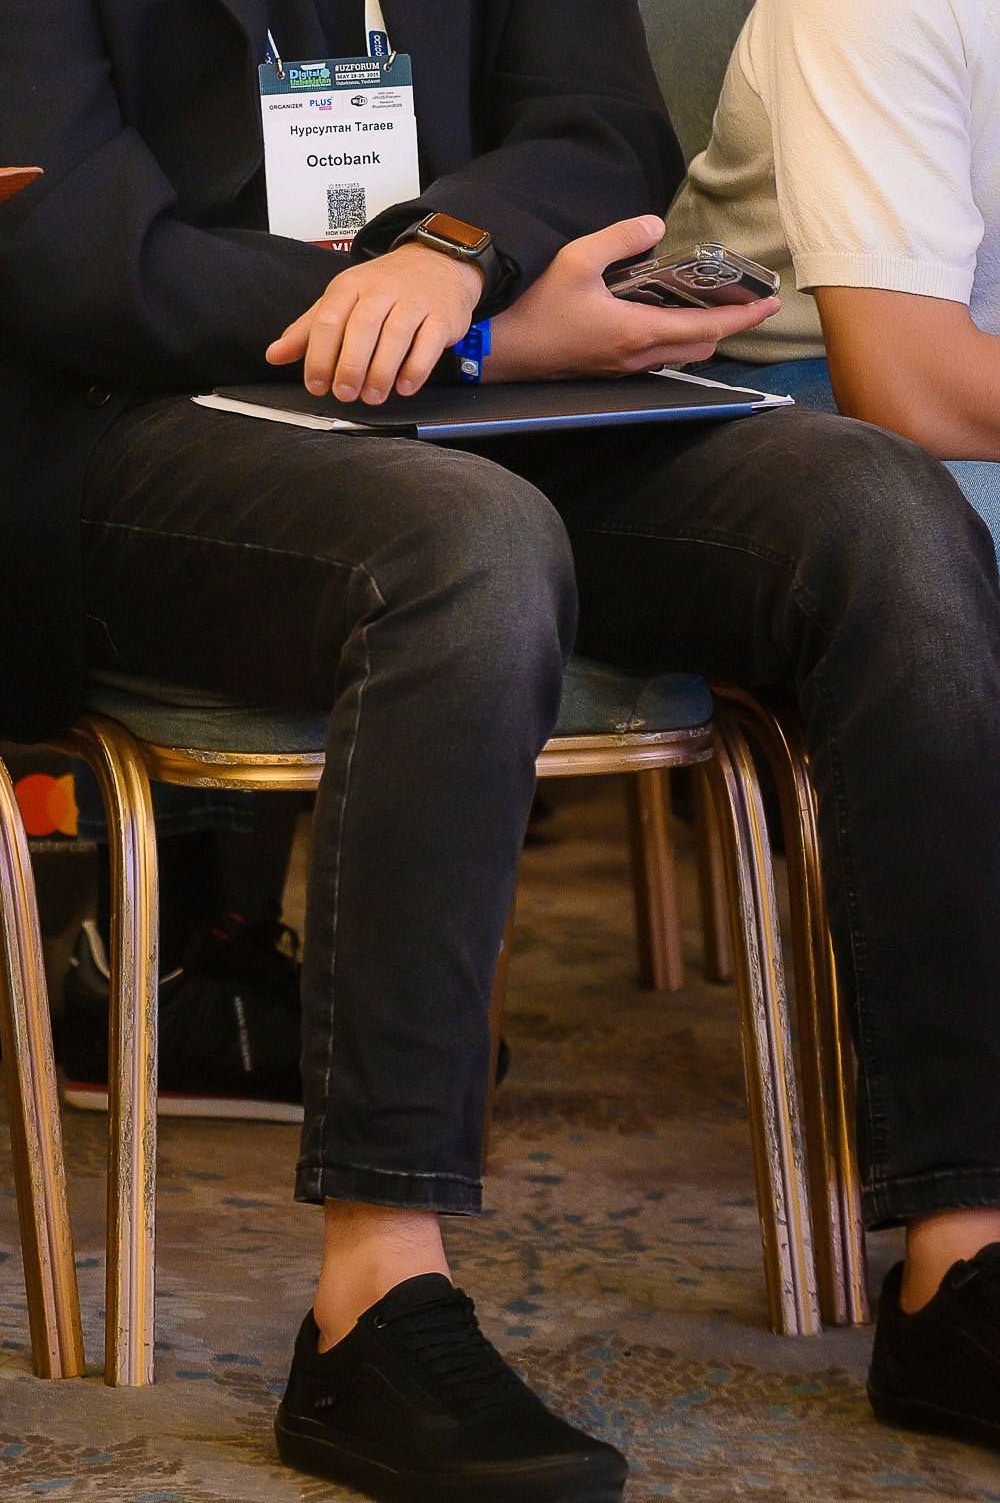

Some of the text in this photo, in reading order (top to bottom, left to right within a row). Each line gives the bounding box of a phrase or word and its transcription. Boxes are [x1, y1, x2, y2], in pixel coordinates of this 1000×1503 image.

[373, 34, 383, 57] octob
[335, 62, 380, 72] #UZFORUM
[289, 69, 320, 80] Digital
[269, 102, 304, 111] ORGANIZER
[309, 97, 332, 108] PLUS
[290, 121, 394, 138] Нурсултан Тагаев
[306, 151, 381, 168] Octobank
[331, 241, 353, 252] VI
